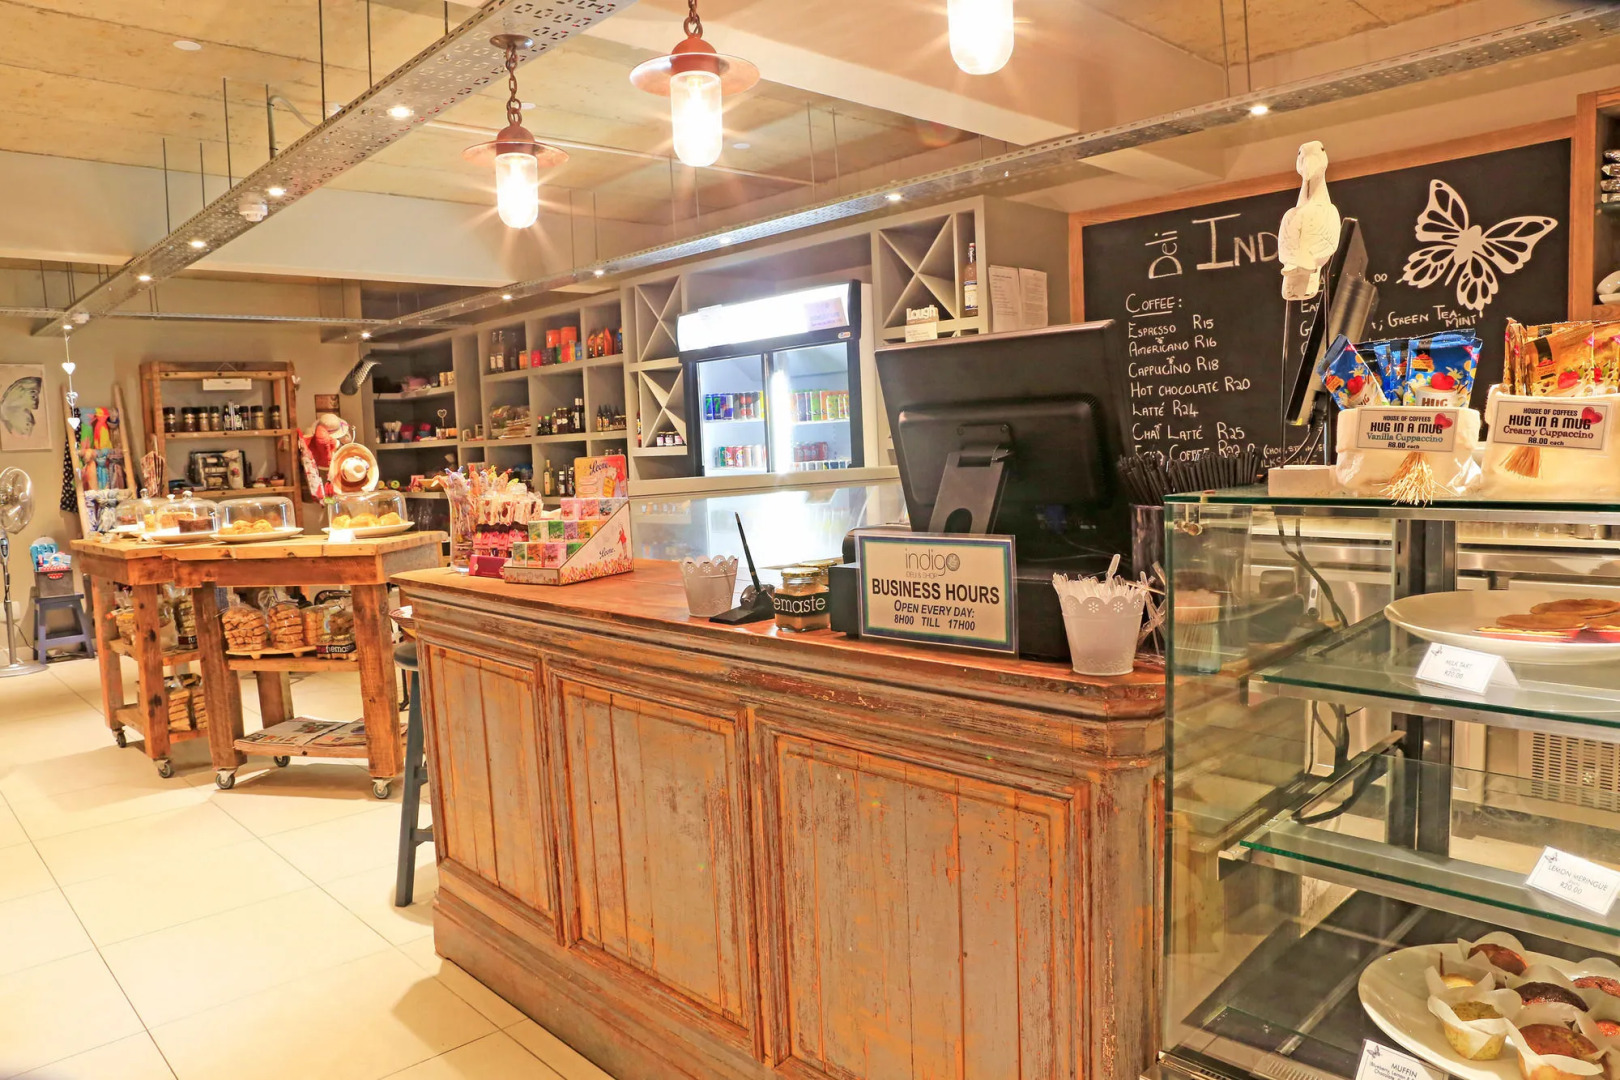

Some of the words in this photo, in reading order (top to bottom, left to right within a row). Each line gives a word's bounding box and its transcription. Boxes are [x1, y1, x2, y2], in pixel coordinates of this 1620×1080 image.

[1145, 230, 1183, 279] Deli
[1128, 321, 1177, 338] ESPRESSO
[1193, 314, 1214, 330] R15
[1387, 311, 1429, 327] GREEN
[1445, 315, 1477, 328] MINT
[1128, 339, 1189, 357] AMERICANO
[1195, 335, 1217, 349] R16
[1128, 360, 1191, 378] CAPPUCINO
[1197, 356, 1219, 371] R18
[1130, 382, 1153, 398] HOT
[1159, 381, 1220, 397] CHOCOLATE
[1224, 376, 1251, 392] R20
[1173, 399, 1199, 418] R24
[1552, 409, 1578, 417] COFFEES
[1217, 421, 1245, 440] R25
[1370, 422, 1390, 433] HUG
[1394, 422, 1404, 433] IN
[1407, 422, 1414, 433] A
[1418, 423, 1443, 434] MUG
[1509, 415, 1532, 426] HUG
[1535, 416, 1545, 427] IN
[1550, 416, 1558, 428] A
[1562, 417, 1592, 430] MUG
[1366, 432, 1394, 441] Vanilla
[1395, 433, 1443, 443] Cuppaccino
[1503, 425, 1538, 436] Creamy
[1540, 428, 1594, 439] Cuppaccino
[1528, 437, 1548, 445] R8.00
[905, 548, 961, 577] indigo
[872, 578, 941, 600] BUSINESS
[946, 583, 1000, 605] HOURS
[894, 600, 919, 614] OPEN
[921, 604, 952, 616] EVERY
[953, 606, 975, 618] DAY:
[894, 614, 914, 625] 8H00
[921, 617, 940, 628] TILL
[948, 619, 975, 631] 17H00
[1548, 864, 1571, 878] LEMON
[1573, 874, 1608, 892] MERINGUE
[1560, 881, 1583, 895] R20.00
[1391, 1063, 1418, 1078] MUFFIN
